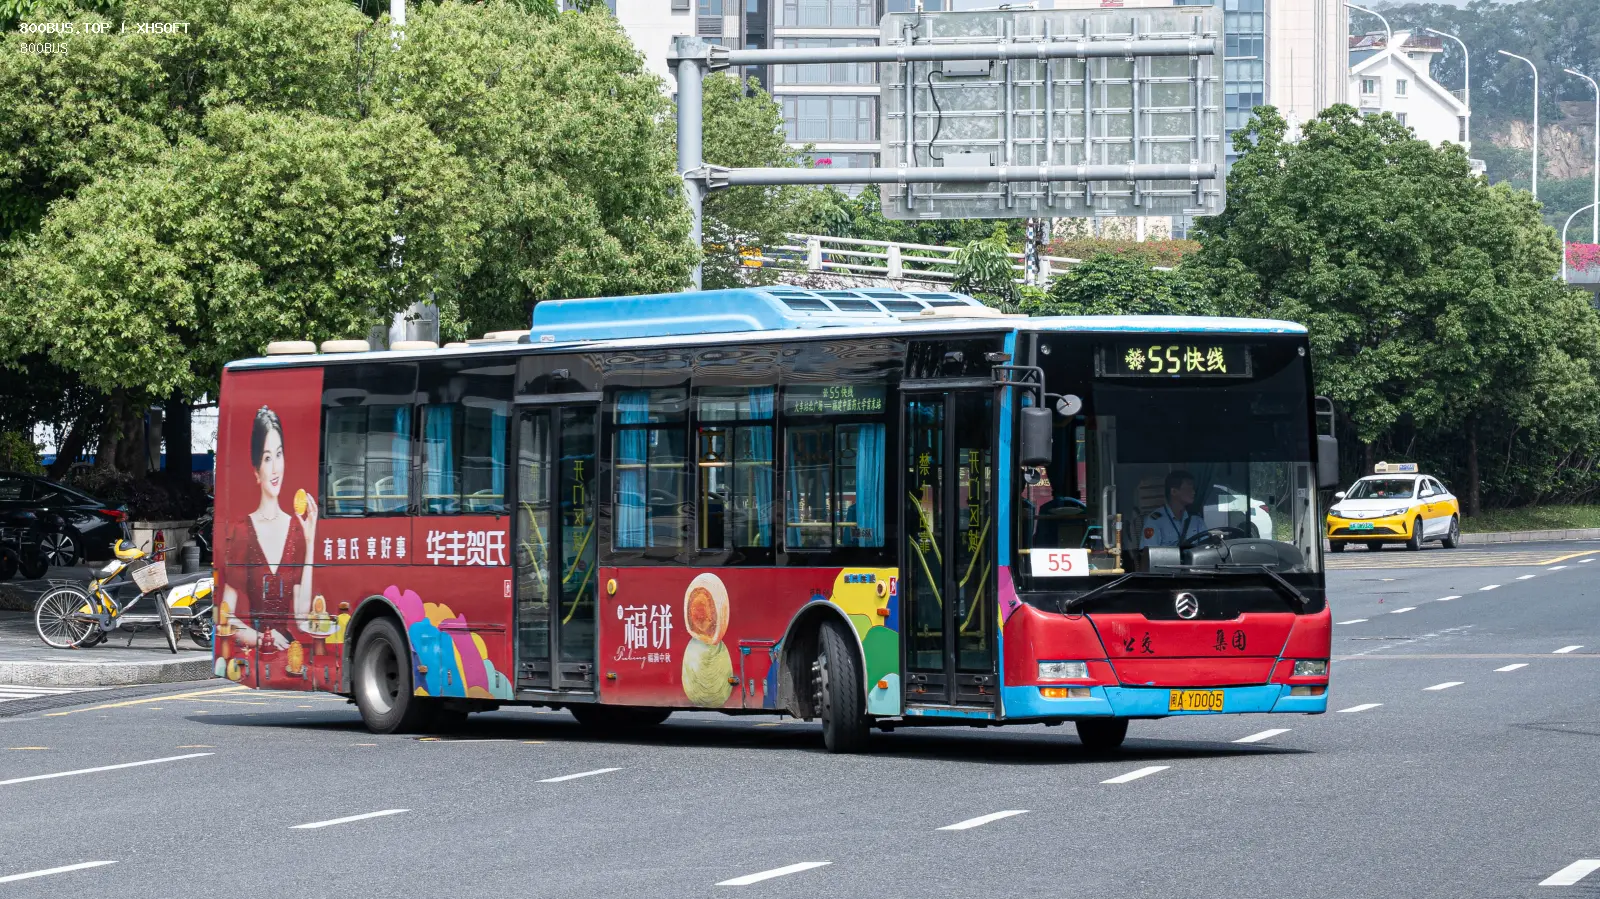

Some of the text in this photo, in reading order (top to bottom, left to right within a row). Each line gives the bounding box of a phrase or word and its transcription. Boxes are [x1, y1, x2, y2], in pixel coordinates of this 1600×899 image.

[1147, 345, 1227, 374] 55快线
[323, 535, 407, 561] 有贺氏 享好事
[426, 530, 506, 566] 华丰贺氏
[1047, 552, 1073, 573] 55
[624, 604, 673, 650] 福饼
